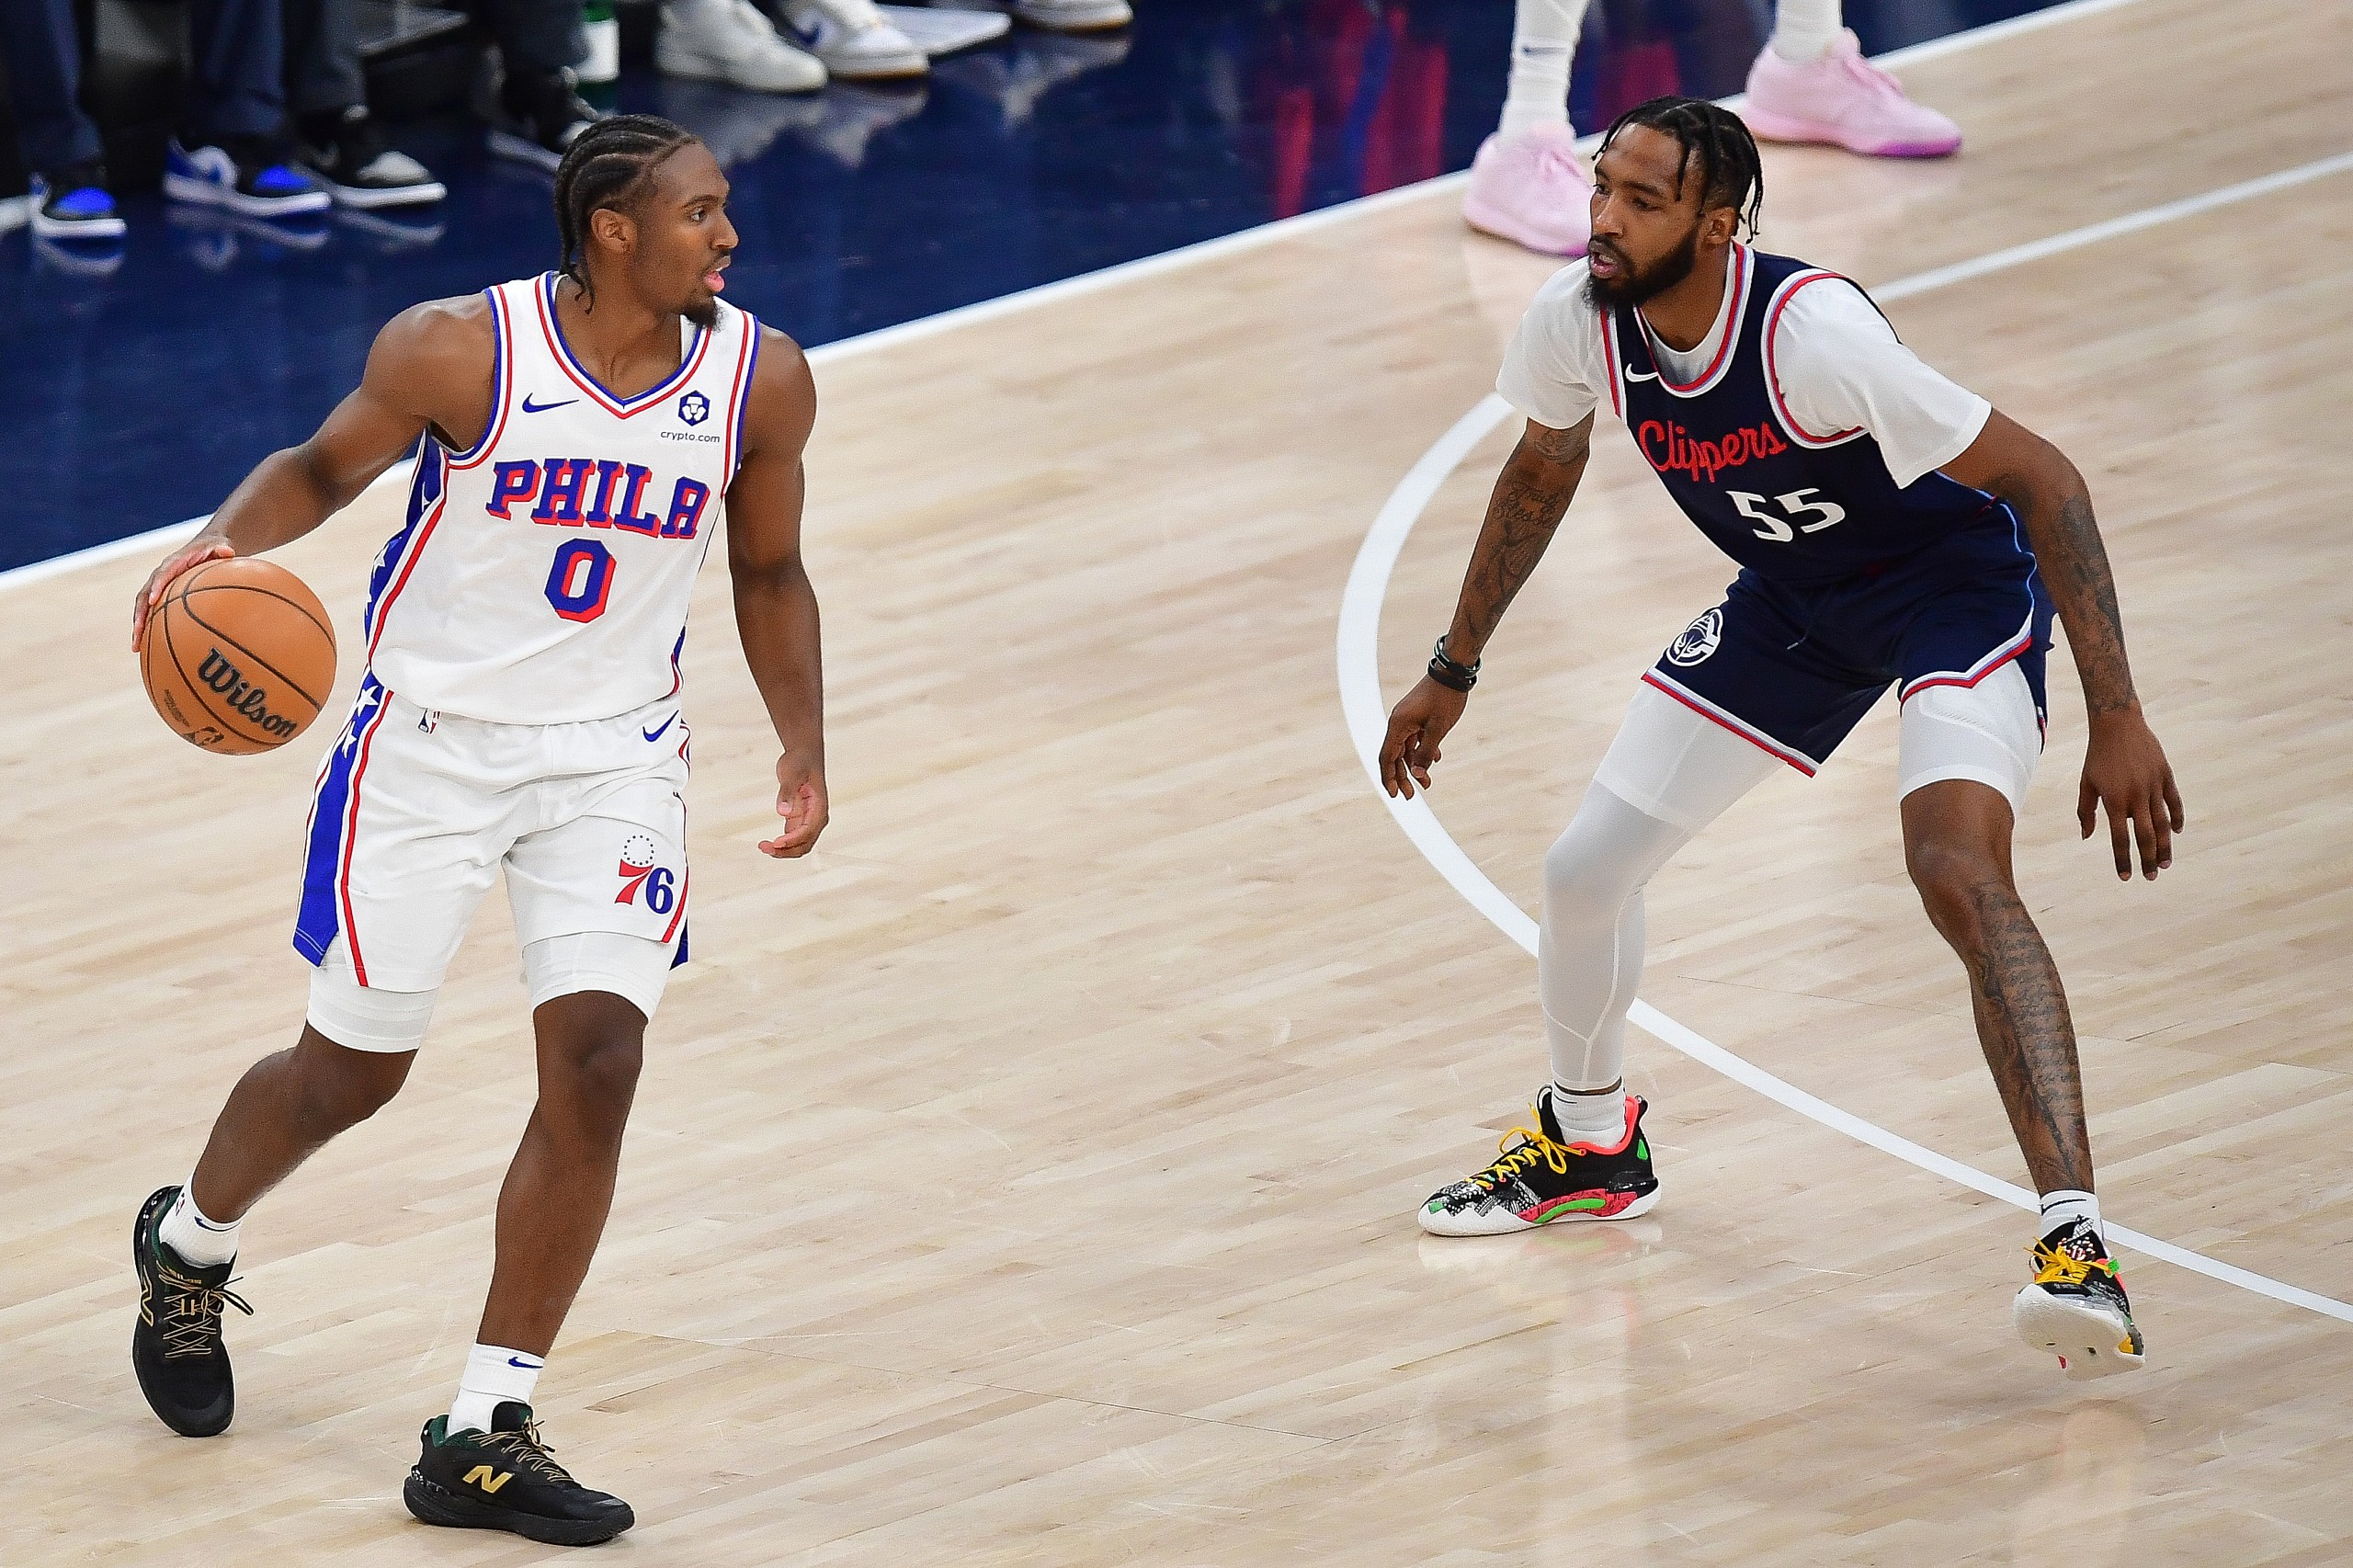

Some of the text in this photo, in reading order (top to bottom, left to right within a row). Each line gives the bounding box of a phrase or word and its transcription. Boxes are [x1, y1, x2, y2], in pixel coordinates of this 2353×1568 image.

[660, 430, 721, 443] crypto.com
[1639, 420, 1788, 483] Clippers
[485, 458, 710, 540] PHILA
[1724, 487, 1847, 542] 55
[543, 538, 617, 623] 0
[197, 646, 298, 738] Wilson
[614, 858, 675, 915] 76
[461, 1464, 515, 1494] N
